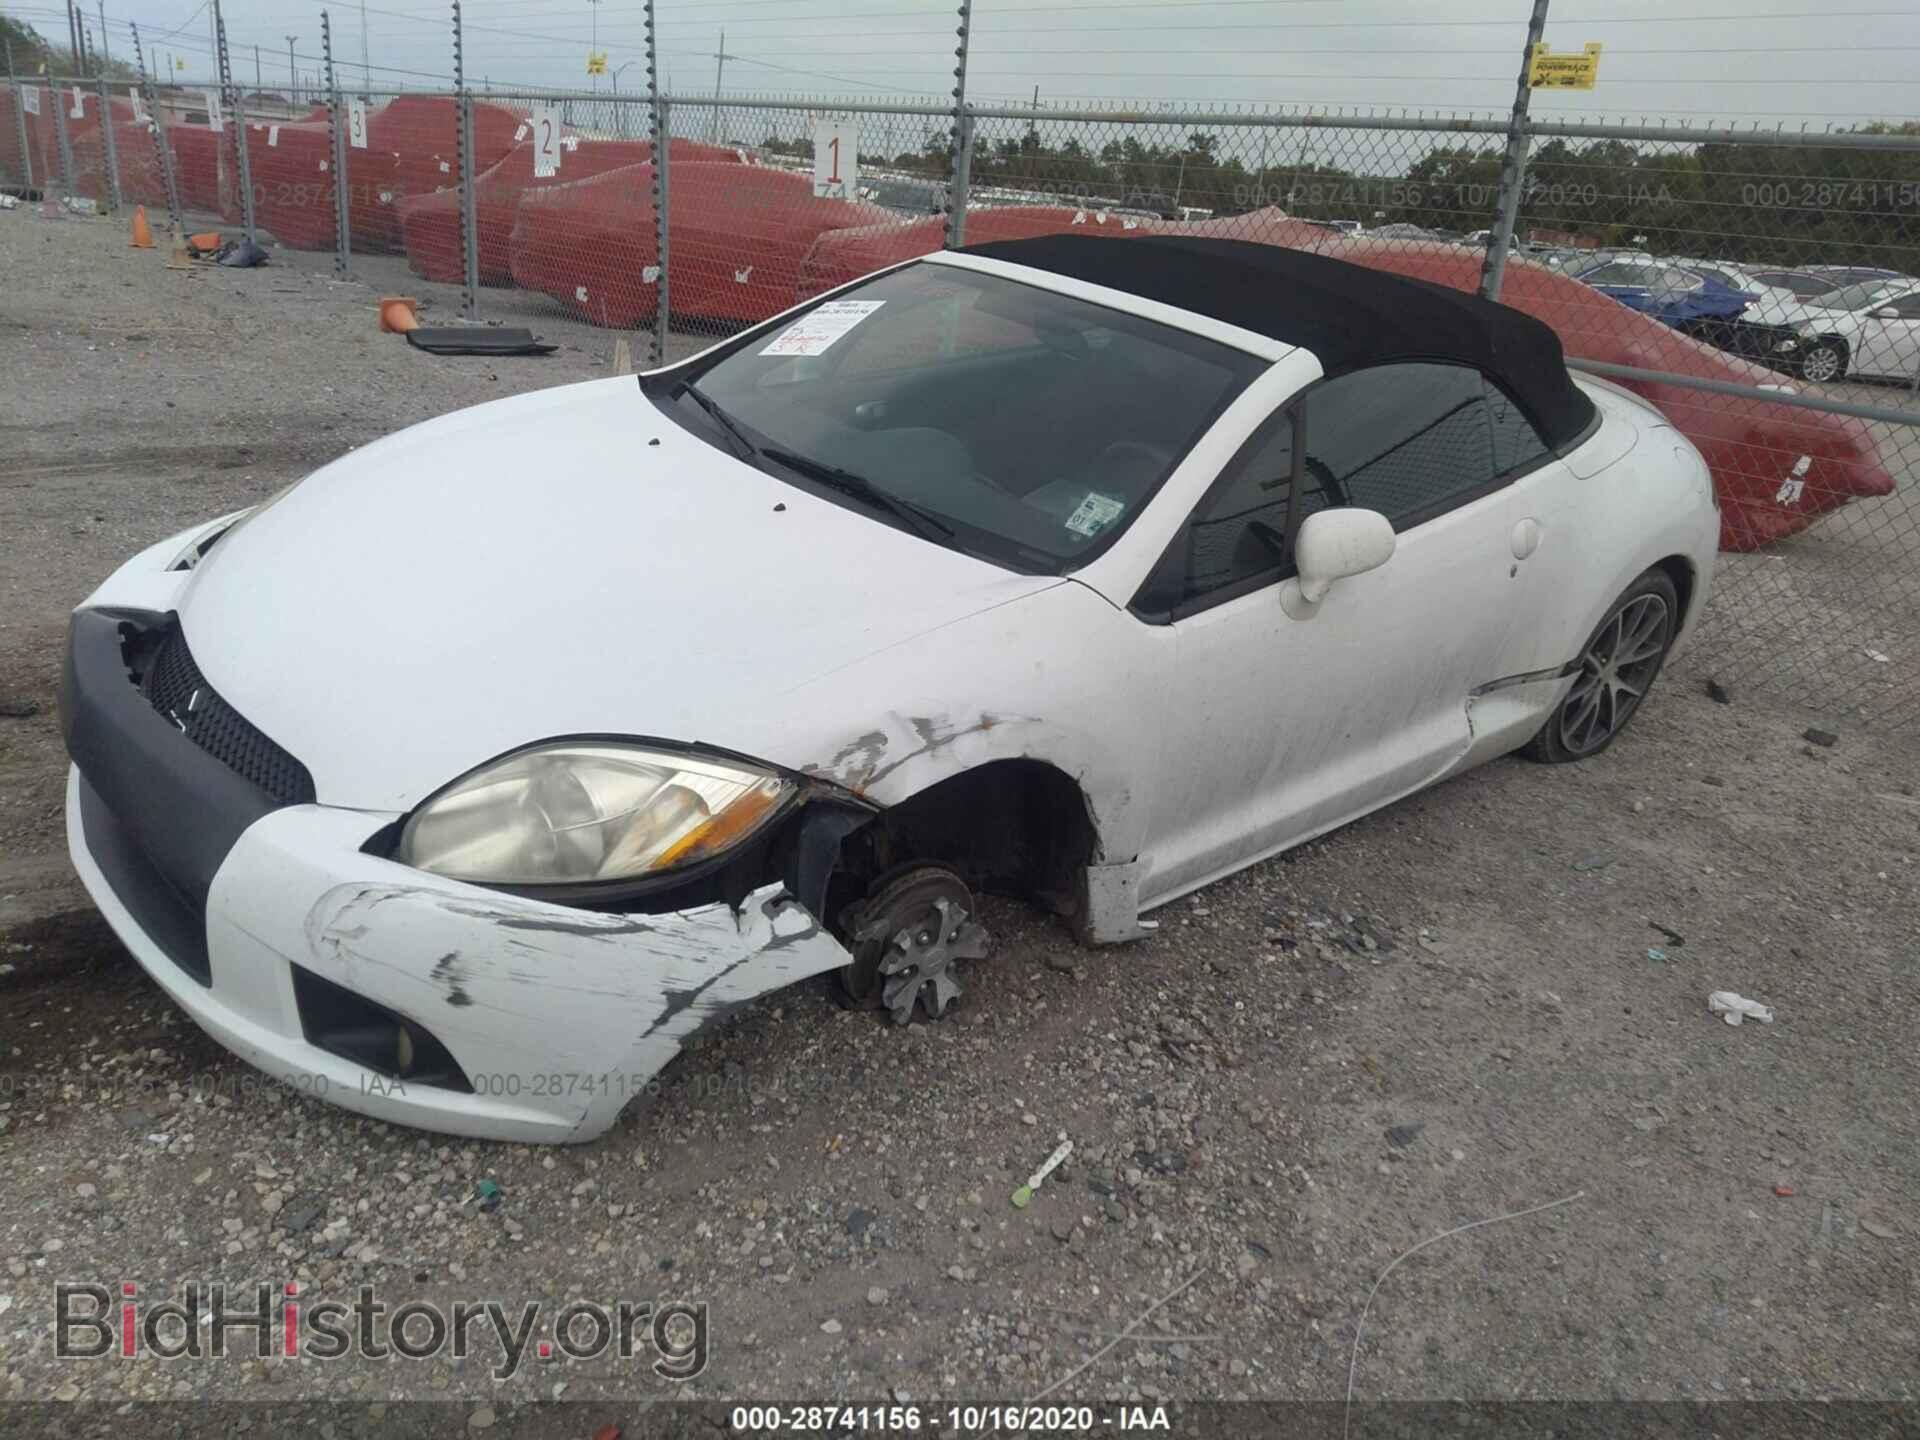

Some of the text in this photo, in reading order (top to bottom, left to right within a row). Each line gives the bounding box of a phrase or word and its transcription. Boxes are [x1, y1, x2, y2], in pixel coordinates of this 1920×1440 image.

[353, 110, 362, 138] 3
[542, 119, 553, 154] 2
[828, 137, 842, 184] 1
